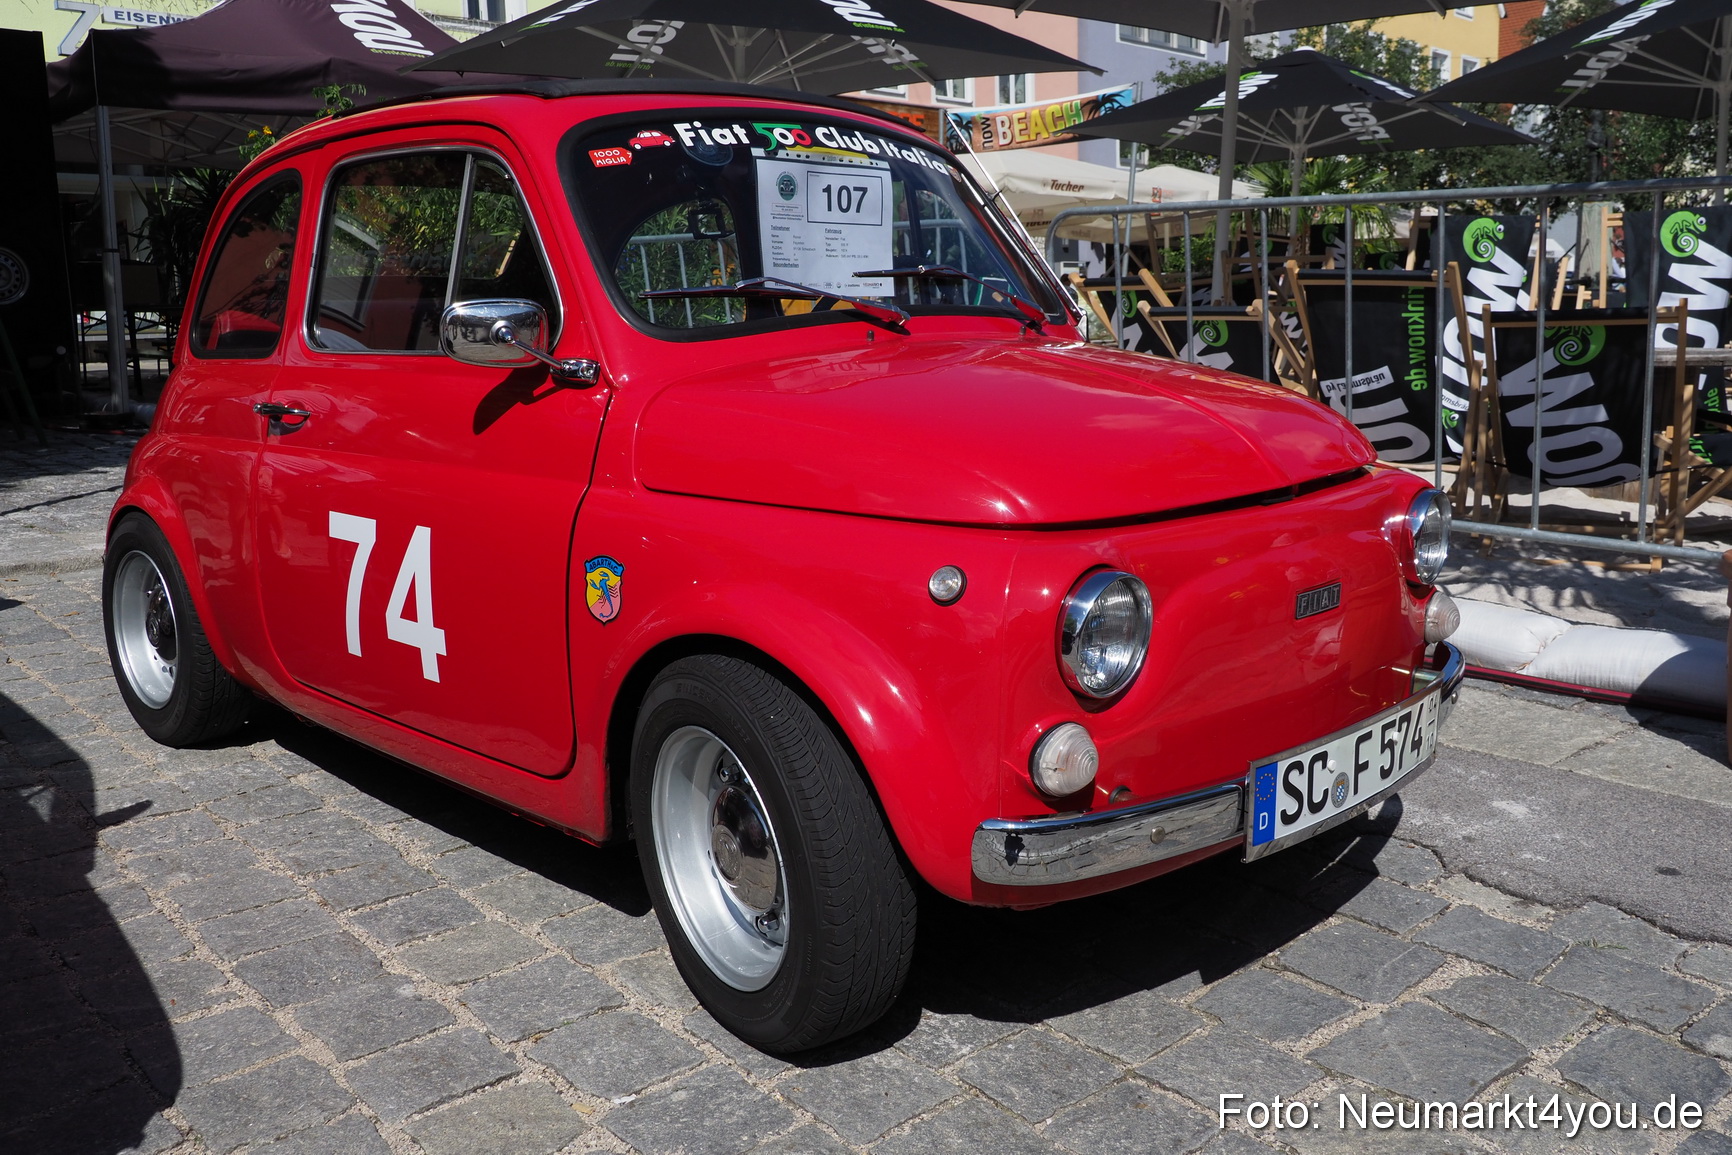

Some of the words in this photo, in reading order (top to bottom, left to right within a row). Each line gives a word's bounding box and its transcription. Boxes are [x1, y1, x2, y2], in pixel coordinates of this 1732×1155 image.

[996, 100, 1083, 146] BEACH
[594, 149, 621, 158] 1000
[596, 157, 627, 166] MIGLIA
[673, 120, 751, 147] Fiat
[752, 122, 812, 151] 500
[815, 126, 880, 155] Club
[878, 138, 949, 176] Italia
[821, 184, 868, 214] 107
[1050, 179, 1085, 193] Tucher
[328, 510, 448, 684] 74
[1300, 585, 1340, 614] FIAT
[1280, 750, 1330, 826] SC
[1353, 729, 1373, 797] F
[1379, 702, 1424, 782] 574
[1259, 811, 1269, 831] D
